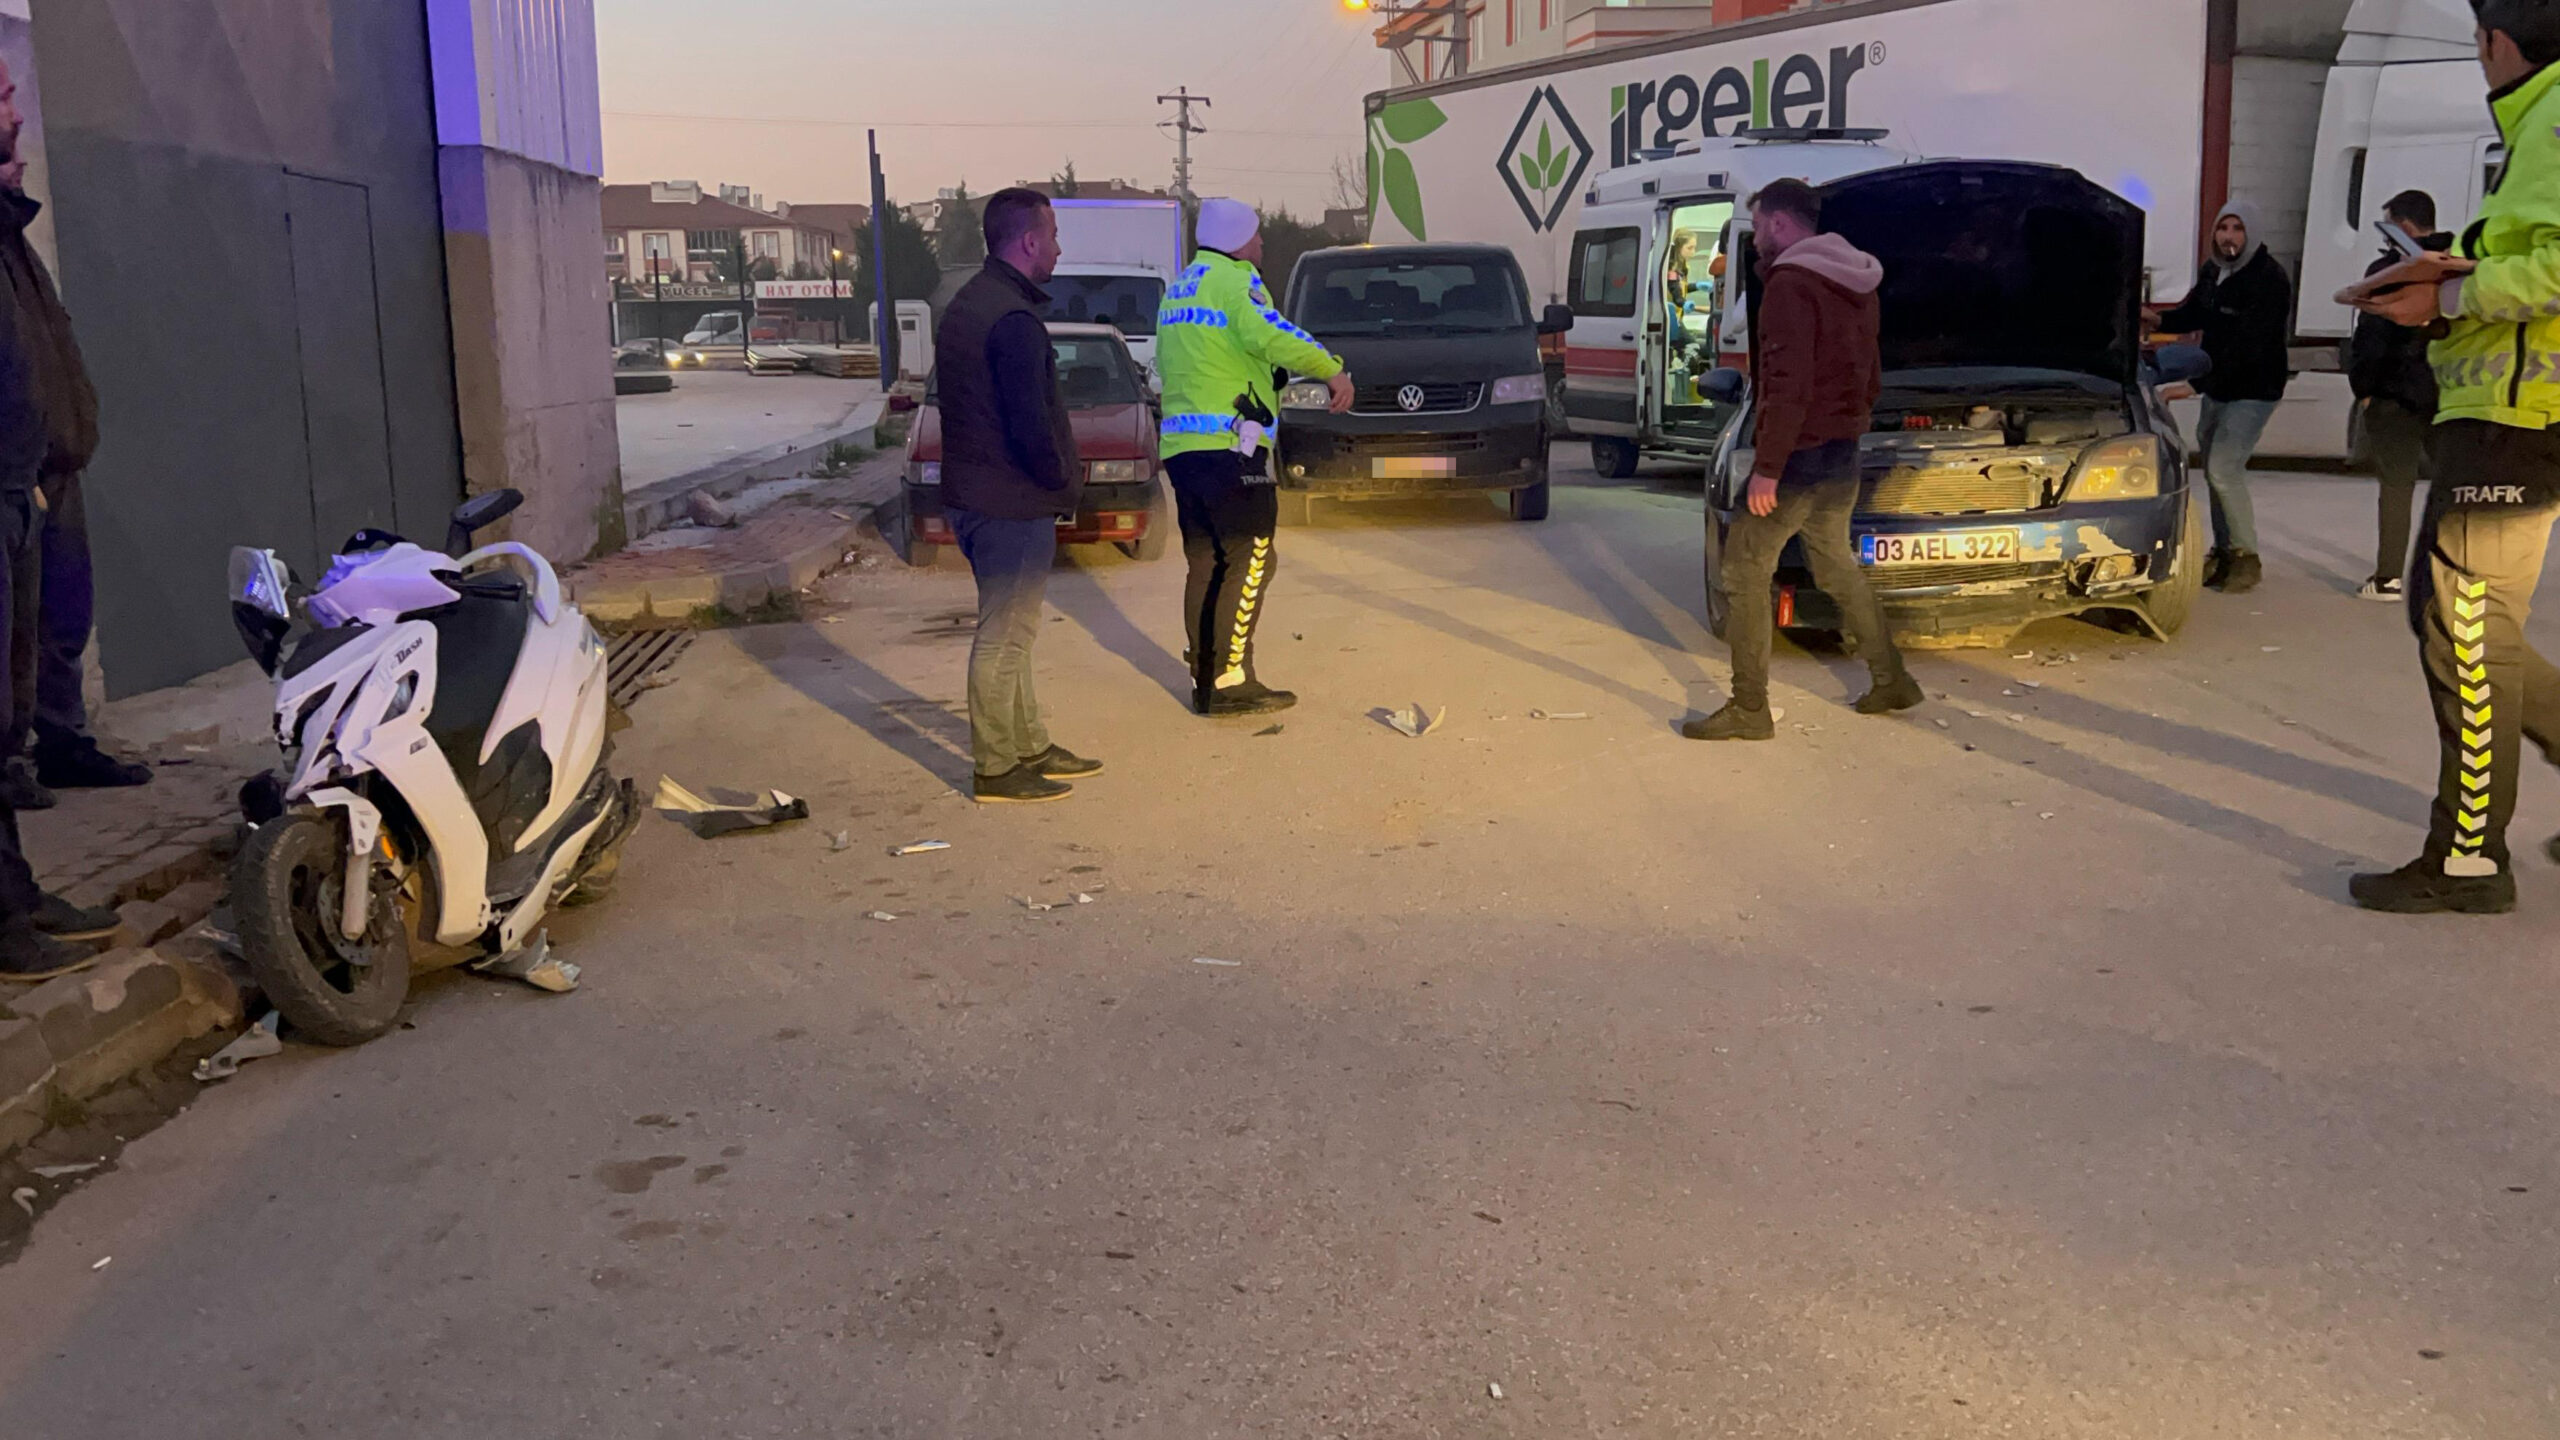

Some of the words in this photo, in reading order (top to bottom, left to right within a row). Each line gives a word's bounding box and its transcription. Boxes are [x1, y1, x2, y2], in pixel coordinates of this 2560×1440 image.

[1611, 43, 1866, 168] irgeler
[765, 286, 794, 297] HAT
[1875, 539, 1904, 562] 03
[1911, 538, 1956, 561] AEL
[1964, 535, 2011, 560] 322
